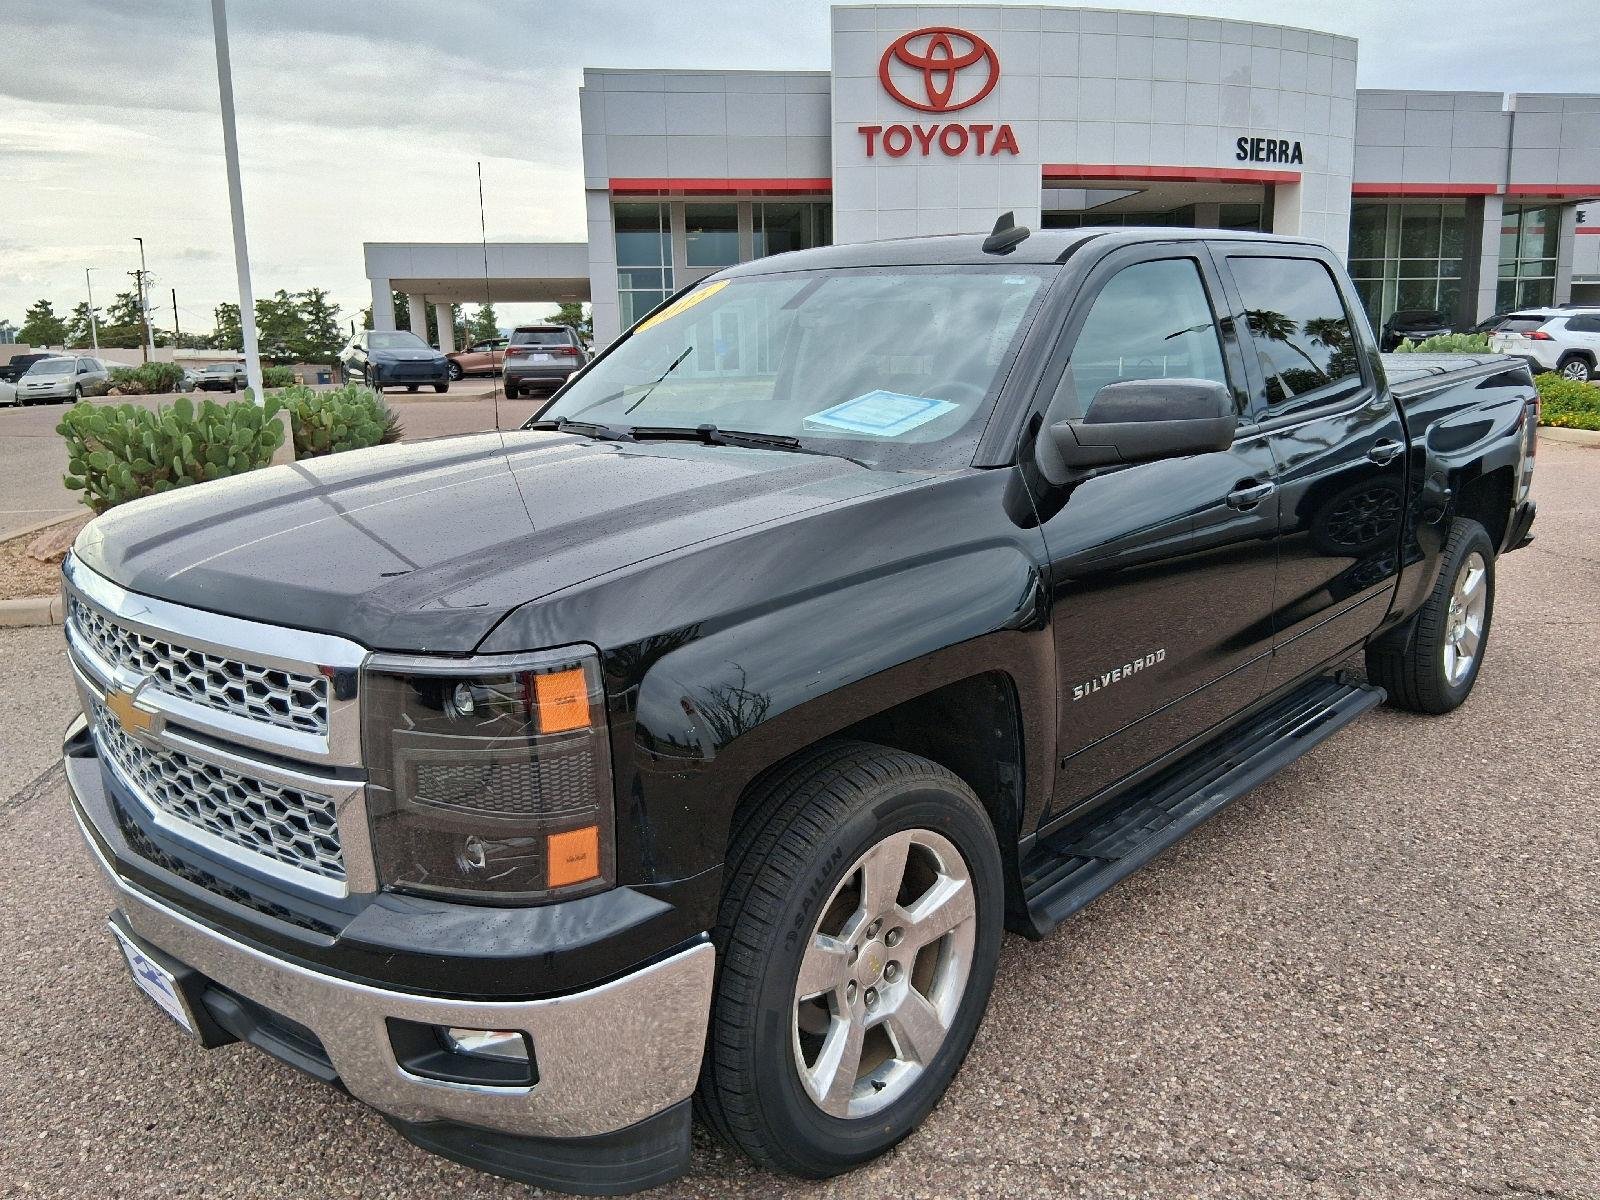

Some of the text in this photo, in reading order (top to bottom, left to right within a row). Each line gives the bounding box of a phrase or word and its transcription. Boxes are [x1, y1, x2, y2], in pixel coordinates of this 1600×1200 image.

[858, 124, 1020, 157] TOYOTA
[1236, 136, 1303, 164] SIERRA
[1072, 648, 1166, 701] SILVERADO
